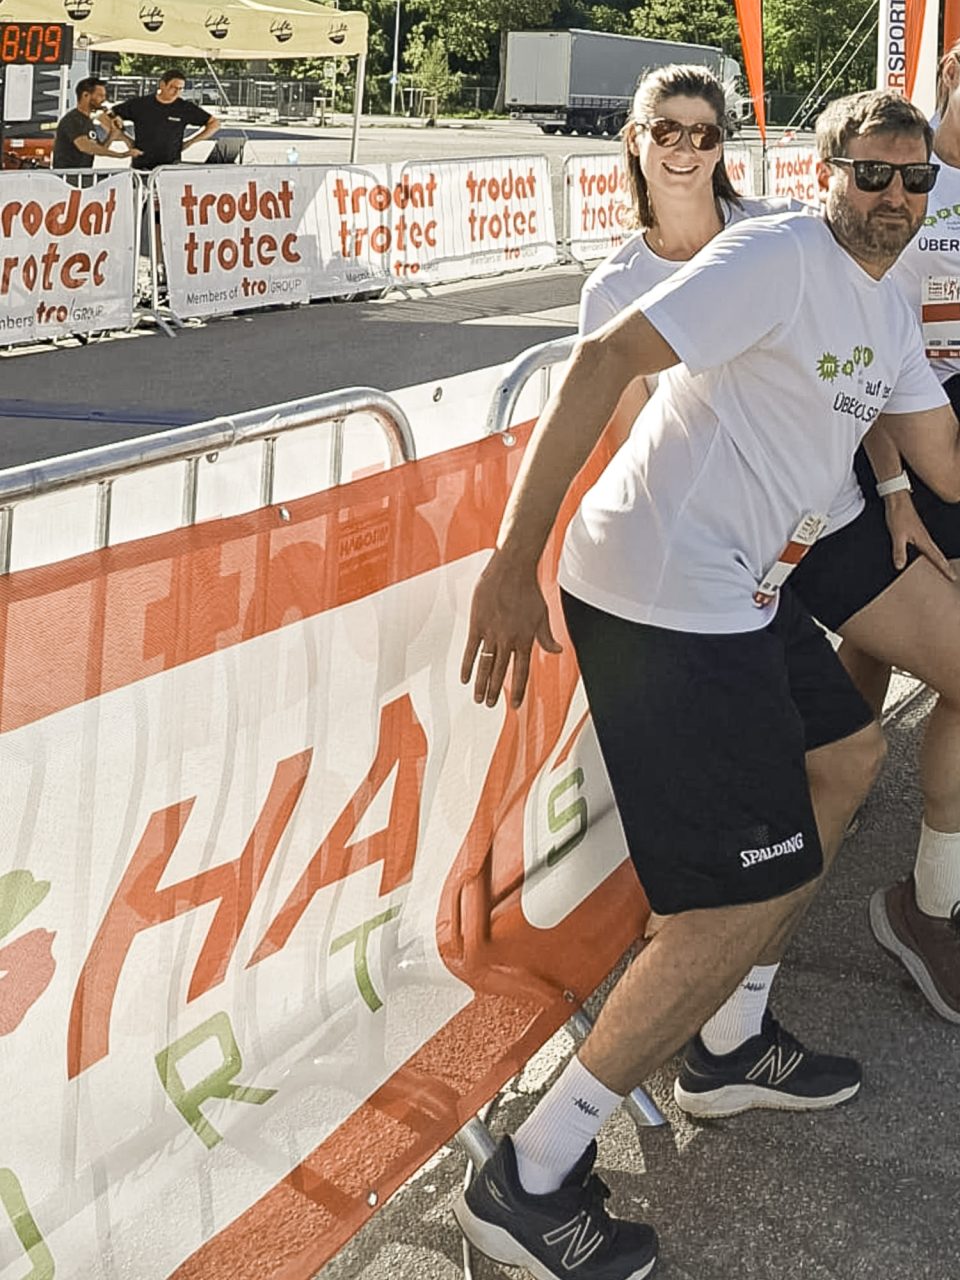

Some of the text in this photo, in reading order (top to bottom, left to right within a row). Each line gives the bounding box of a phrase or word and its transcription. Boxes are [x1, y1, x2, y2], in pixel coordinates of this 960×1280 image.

[139, 6, 165, 21] Life
[2, 25, 62, 62] 8:09
[180, 180, 294, 226] trodat
[333, 173, 437, 216] trodat
[466, 167, 536, 204] trodat
[338, 215, 437, 258] trotec
[468, 205, 537, 242] trotec
[184, 227, 301, 275] trotec
[187, 290, 227, 305] Members
[740, 832, 804, 868] SPALDING
